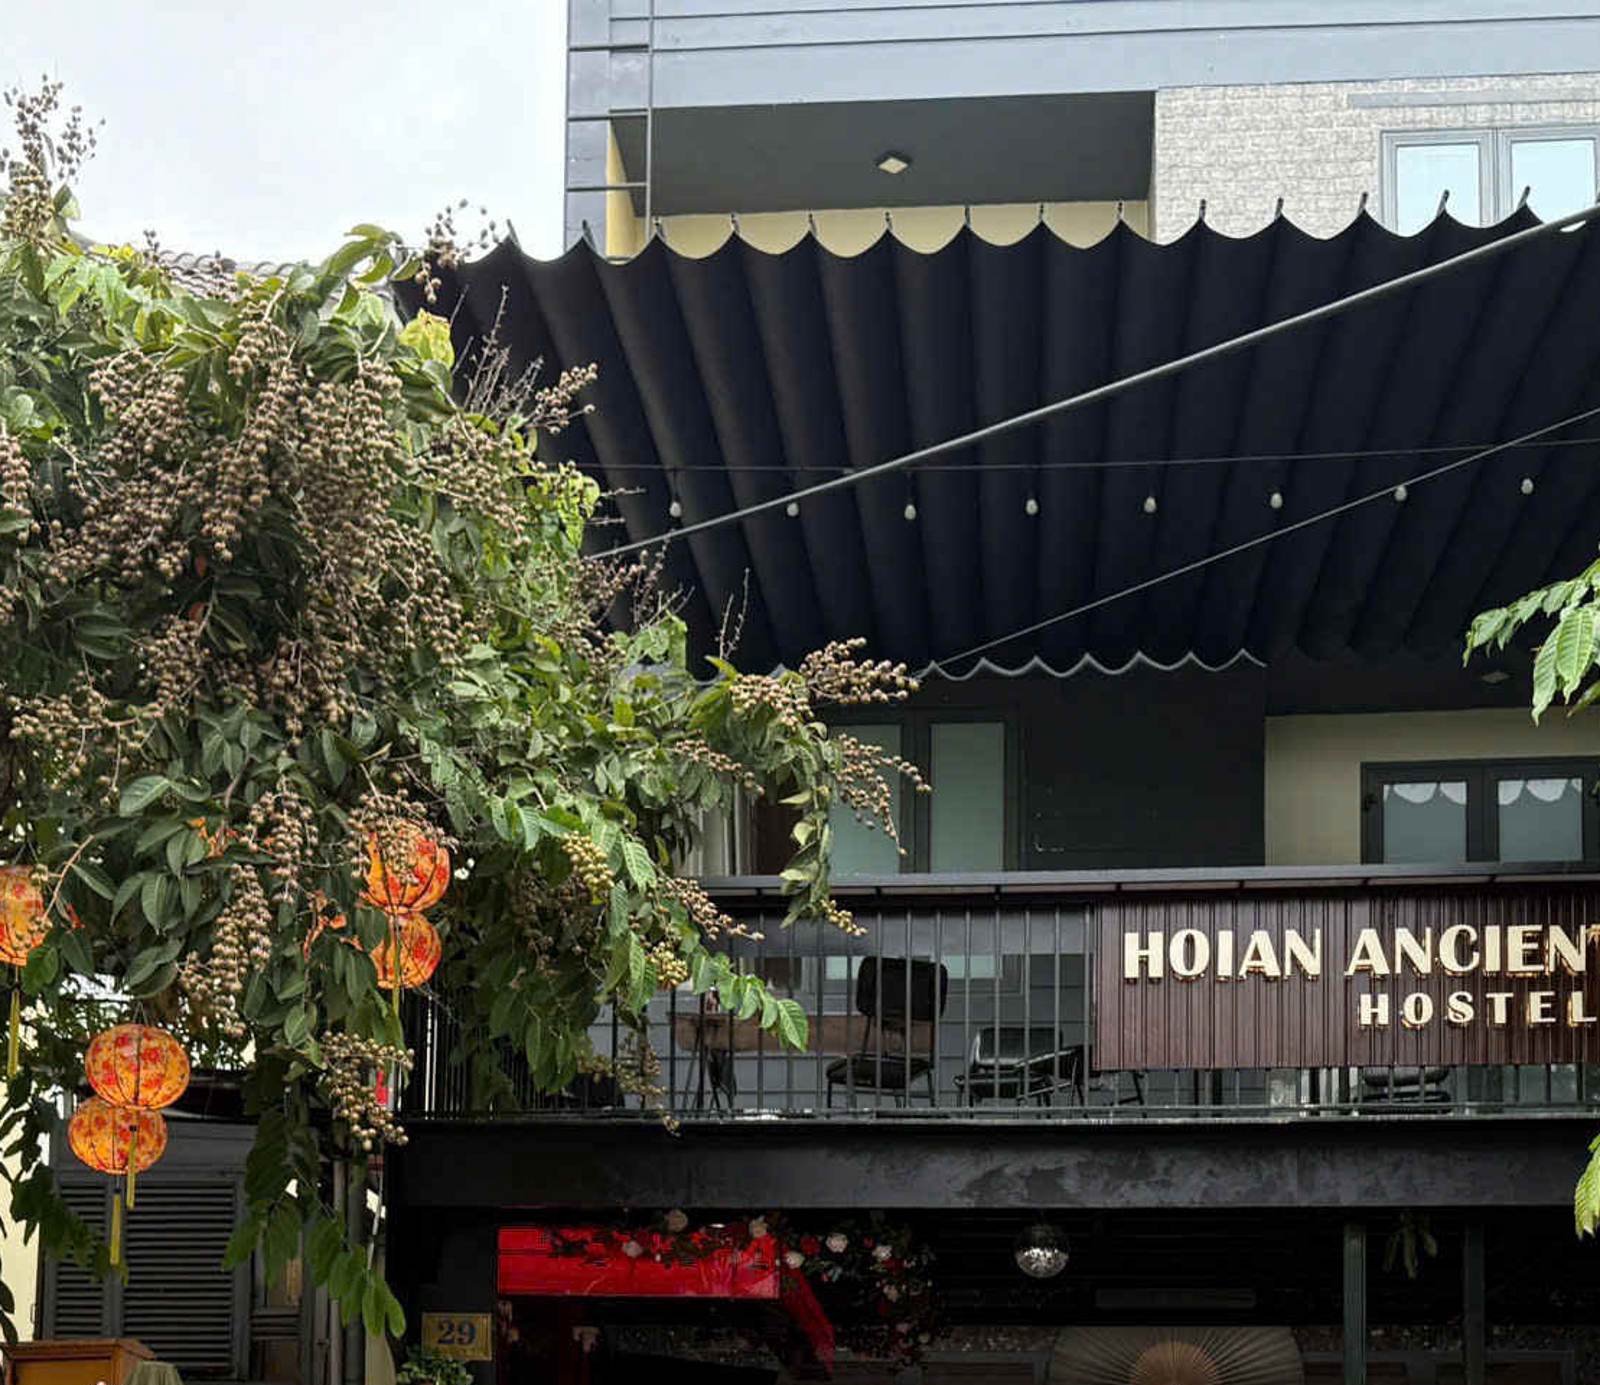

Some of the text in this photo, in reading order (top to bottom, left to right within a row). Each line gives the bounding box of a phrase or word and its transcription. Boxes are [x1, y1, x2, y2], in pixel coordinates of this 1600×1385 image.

[1123, 927, 1321, 980] HOIAN
[1359, 990, 1598, 1026] HOSTEL
[437, 1320, 477, 1345] 29
